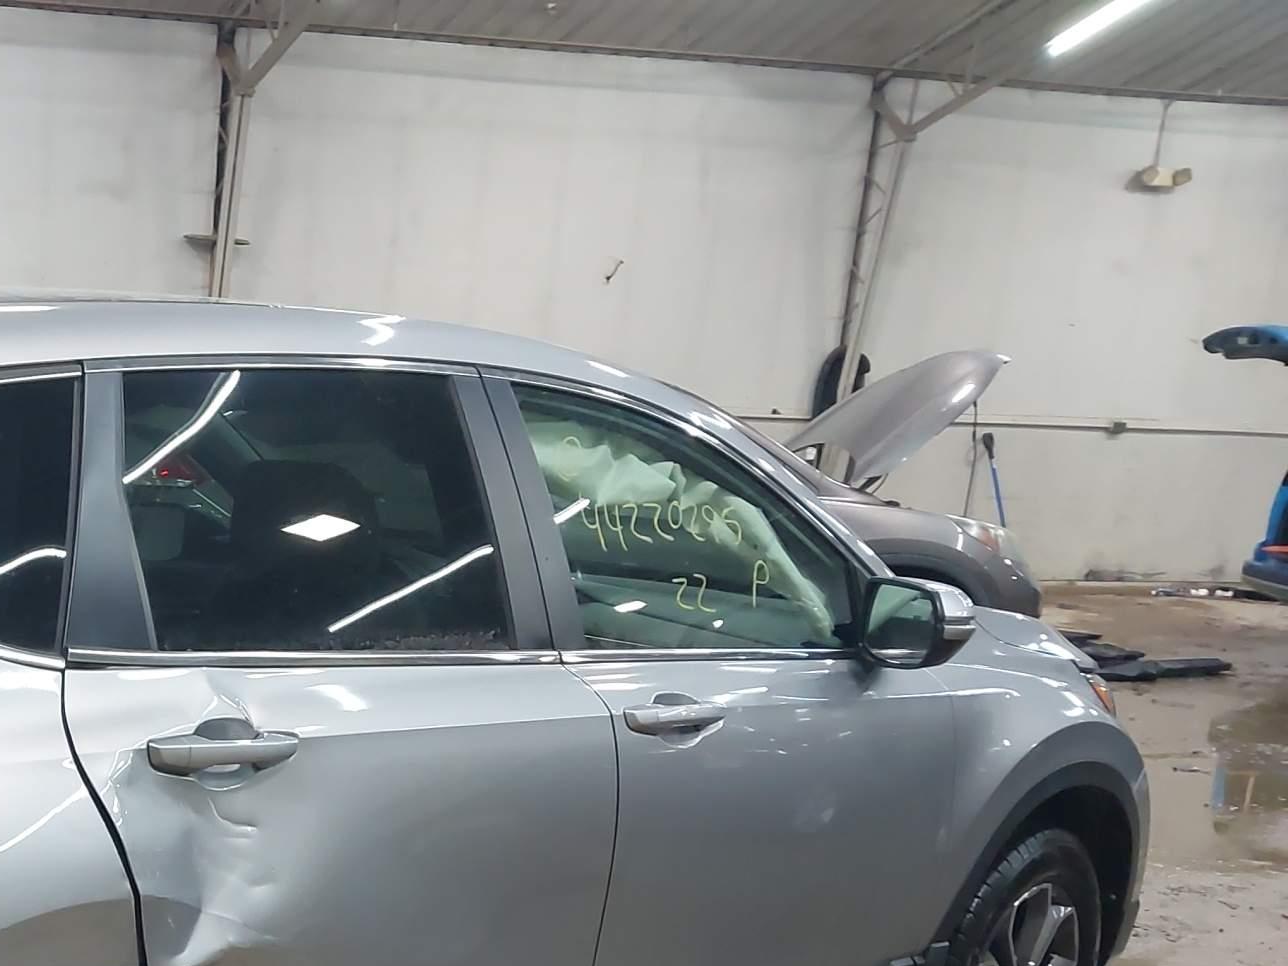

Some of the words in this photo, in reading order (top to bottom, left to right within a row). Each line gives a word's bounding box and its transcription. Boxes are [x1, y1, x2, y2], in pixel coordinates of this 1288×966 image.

[578, 490, 744, 552] 44220295
[671, 573, 717, 613] 22
[752, 560, 770, 608] P
